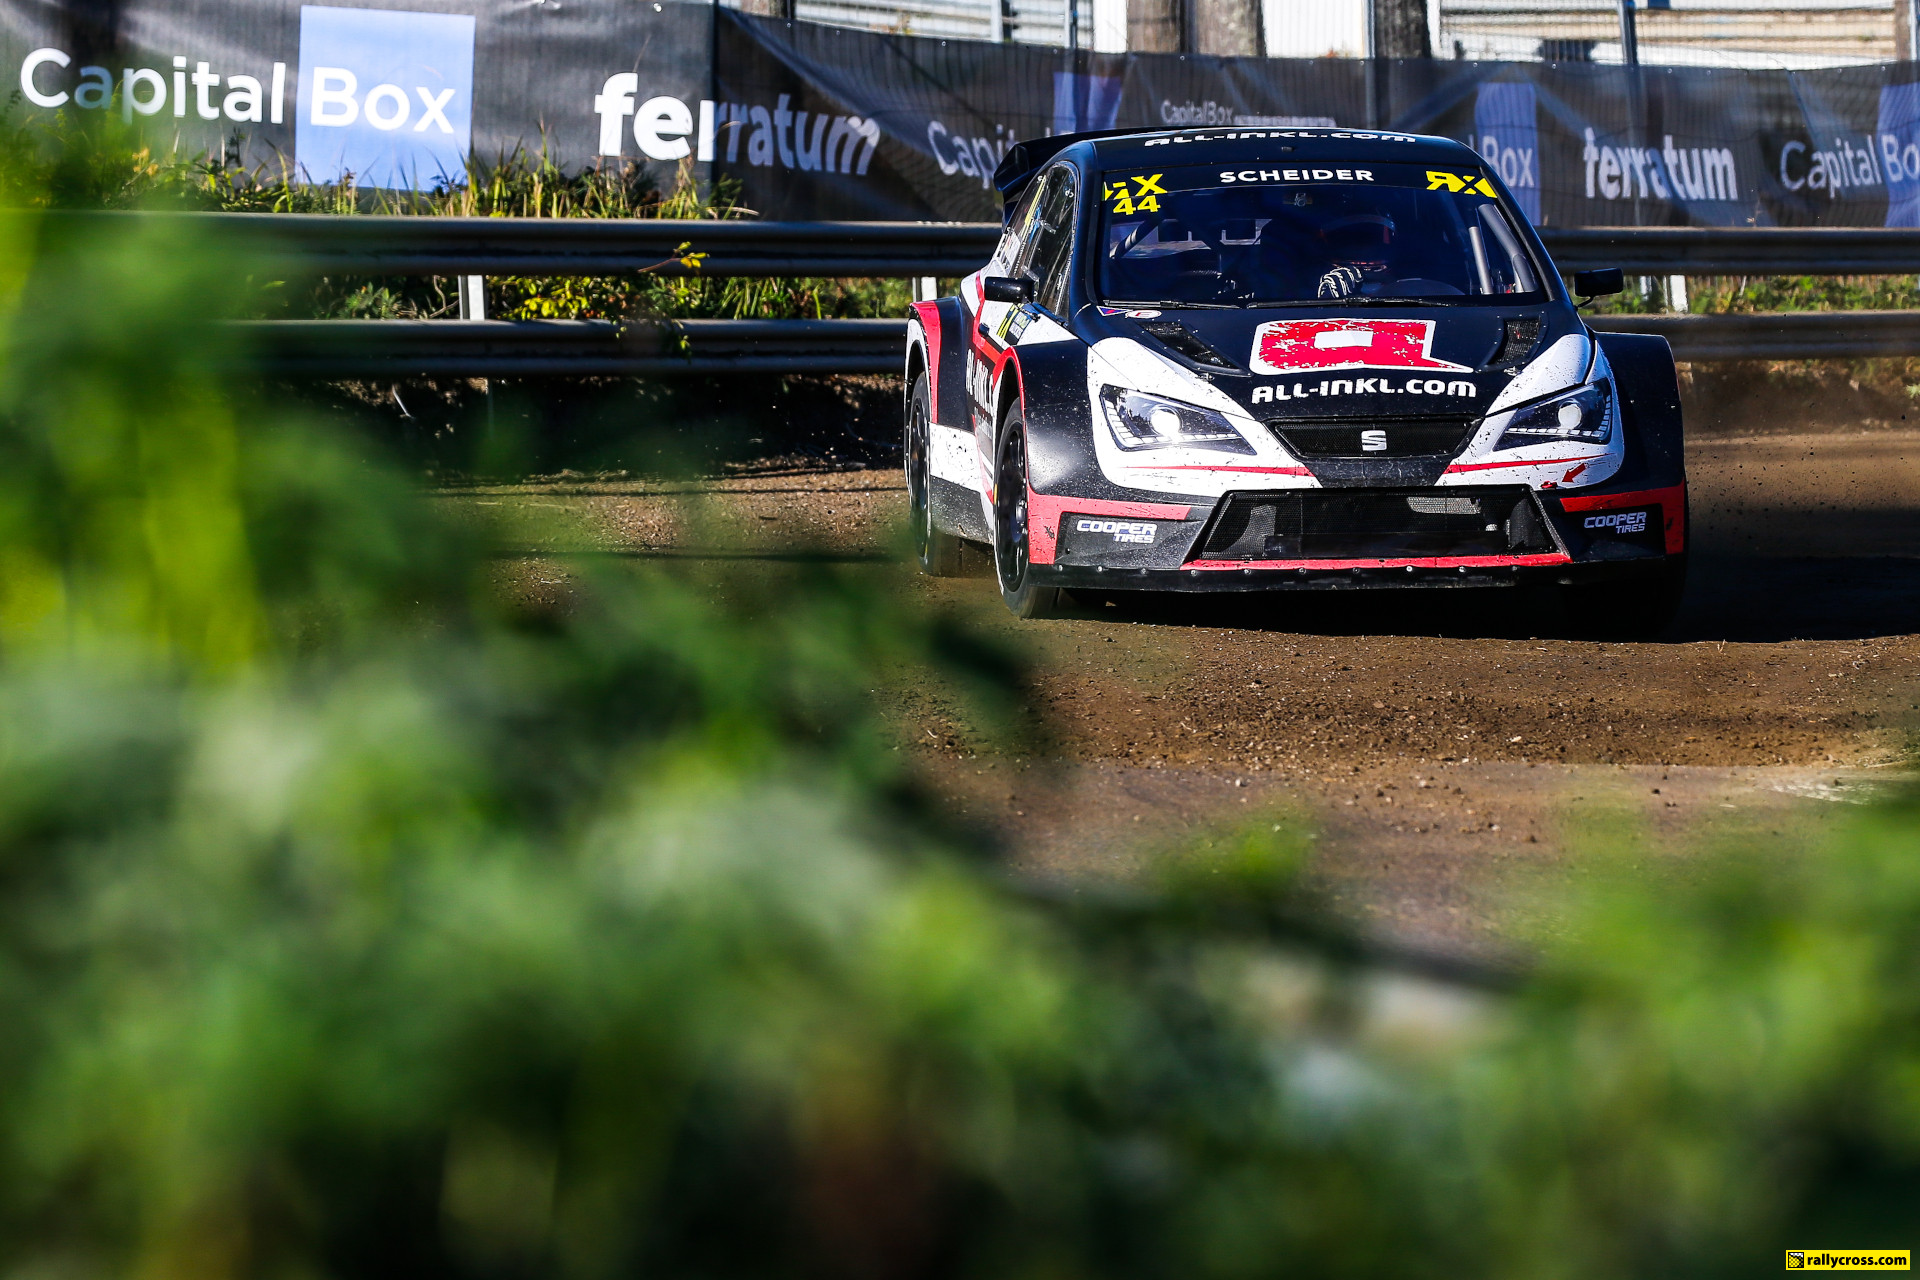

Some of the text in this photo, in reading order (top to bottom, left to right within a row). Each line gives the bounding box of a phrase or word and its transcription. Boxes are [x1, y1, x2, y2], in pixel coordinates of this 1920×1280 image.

[20, 47, 456, 134] Capital Box
[594, 72, 881, 175] ferratum
[1583, 127, 1738, 199] ferratum
[1781, 134, 1920, 199] Capital Bo
[1220, 169, 1375, 183] SCHEIDER
[1113, 195, 1161, 215] 44
[1077, 520, 1157, 535] COOPER
[1584, 512, 1647, 528] COOPER
[1616, 523, 1645, 534] TIRES
[1113, 533, 1154, 543] TIRES
